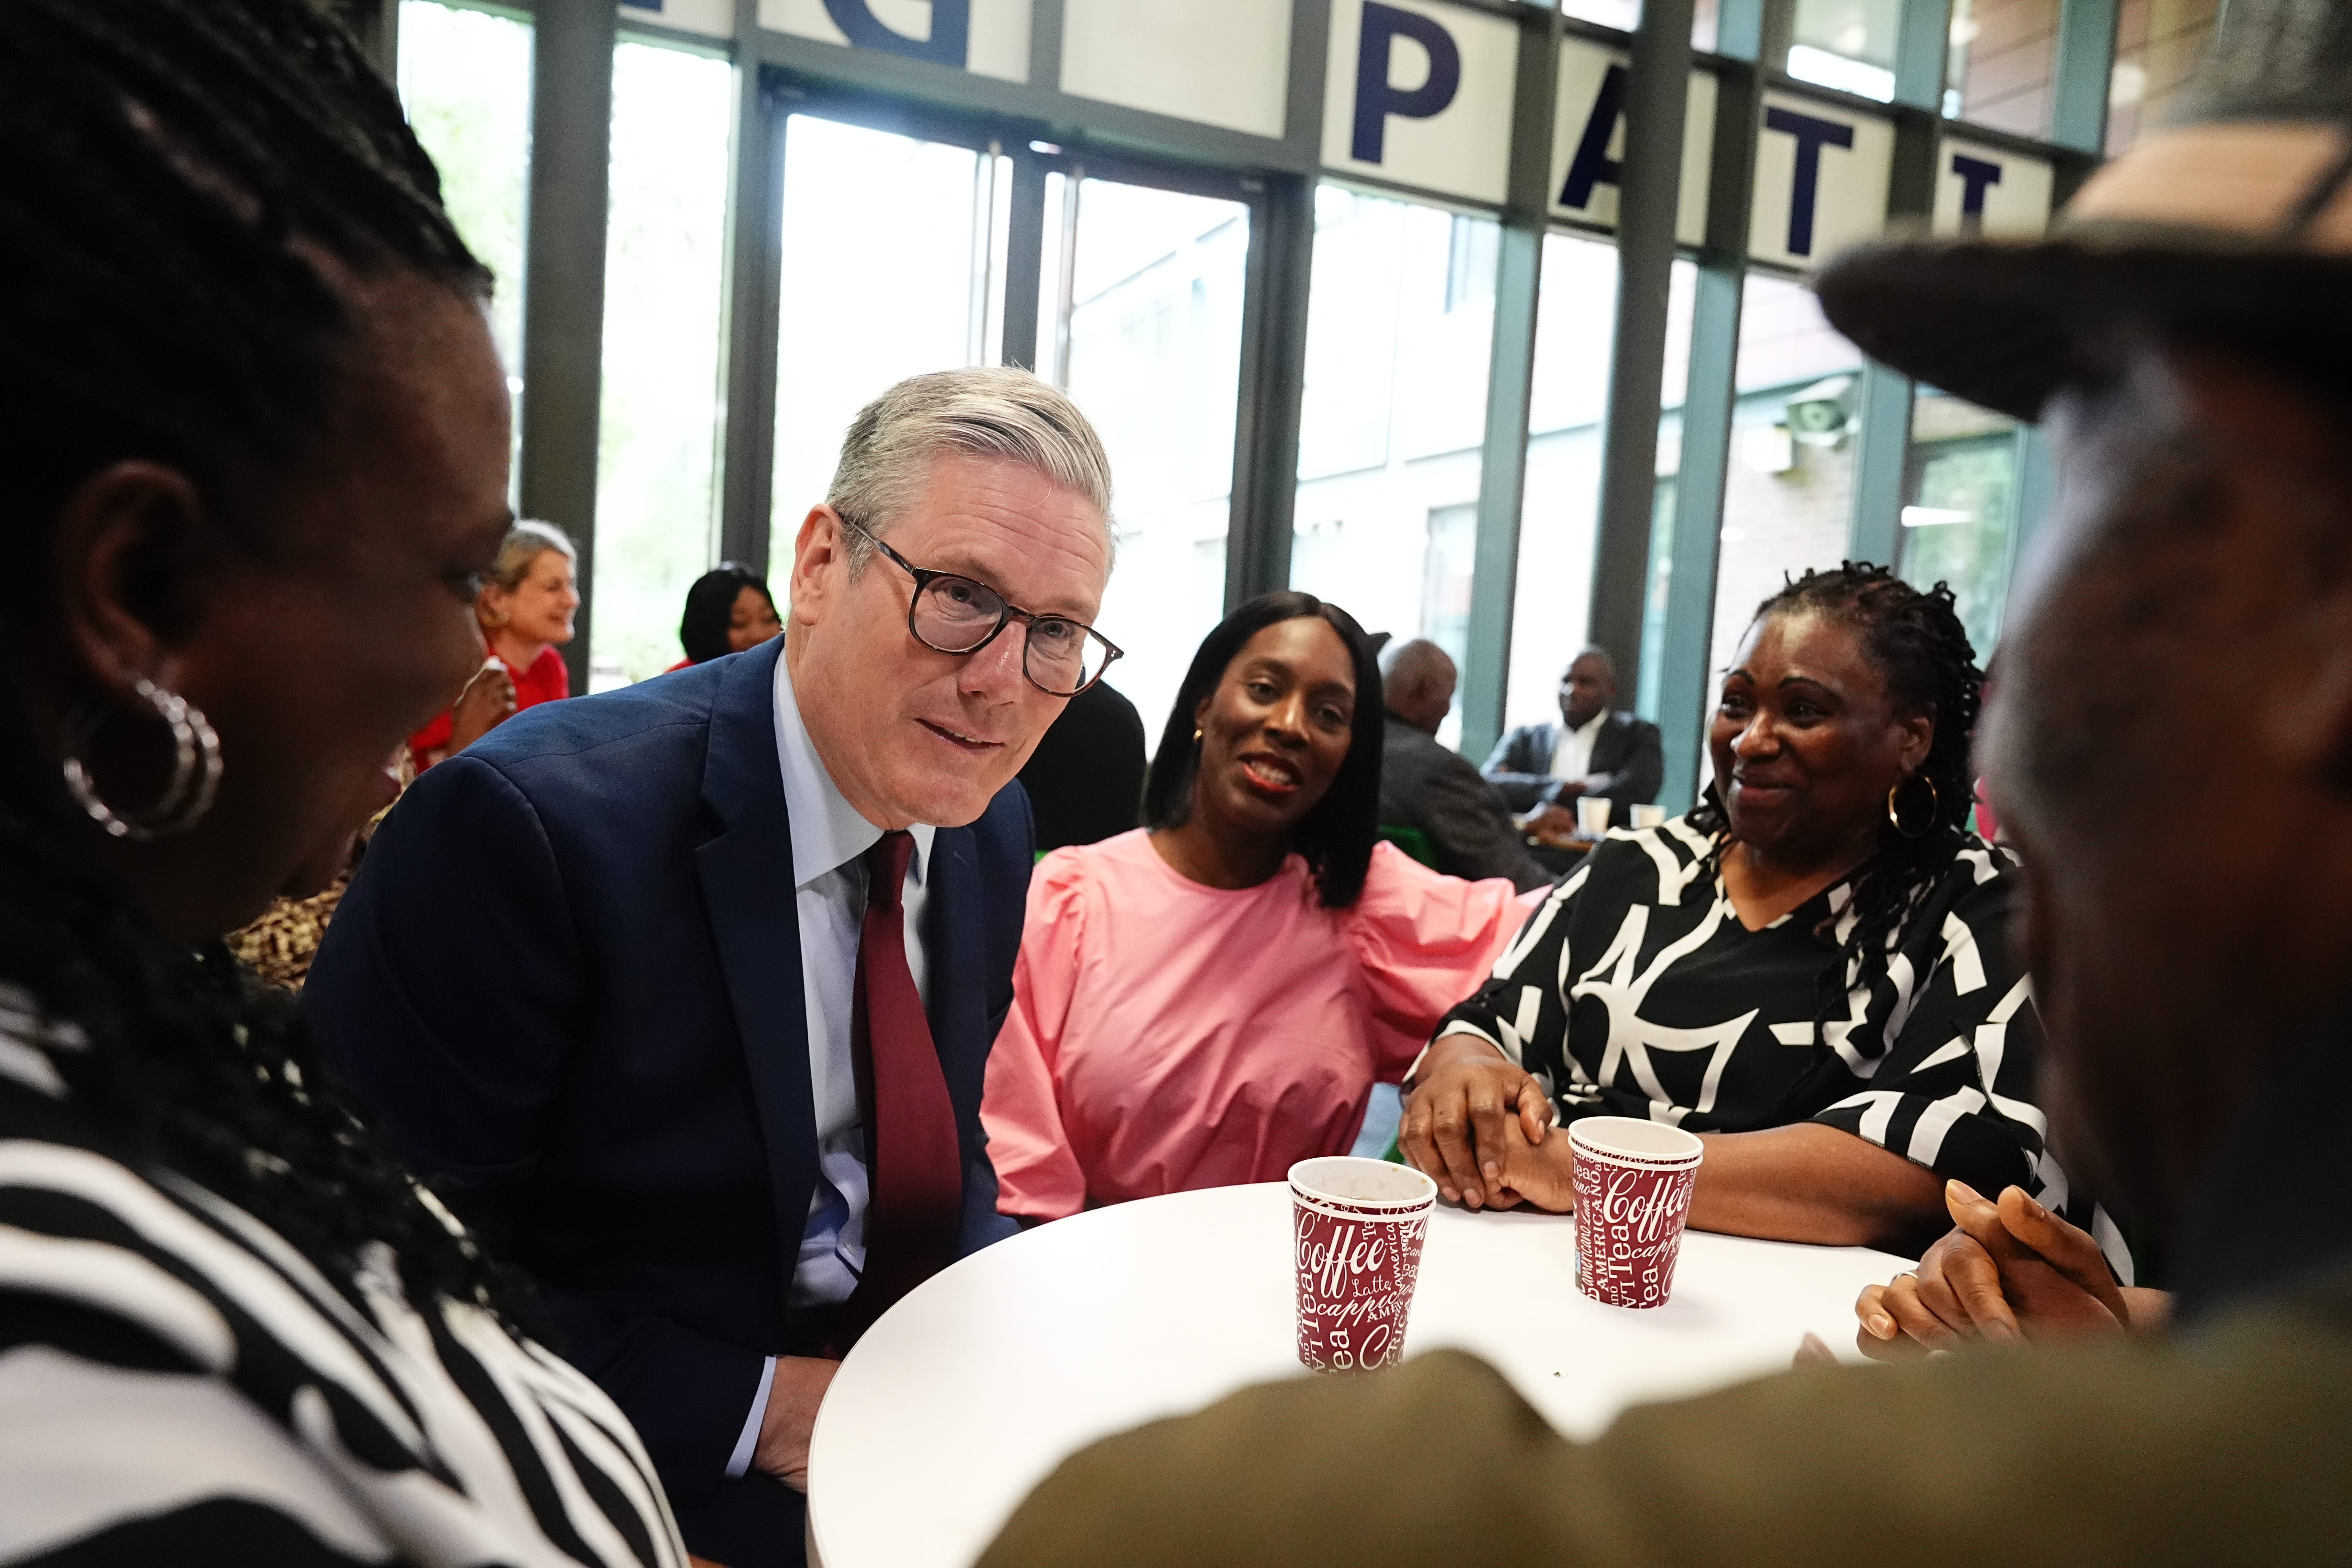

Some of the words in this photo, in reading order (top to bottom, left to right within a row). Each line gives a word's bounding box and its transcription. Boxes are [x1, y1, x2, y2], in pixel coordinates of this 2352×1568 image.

[1590, 1170, 1609, 1292] AMERICANO
[1604, 1171, 1688, 1243] Coffee
[1297, 1210, 1387, 1299] Coffee
[1578, 1225, 1593, 1287] americano
[1607, 1223, 1633, 1279] Tea
[1300, 1272, 1320, 1334] Tea
[1352, 1274, 1392, 1298] Latte
